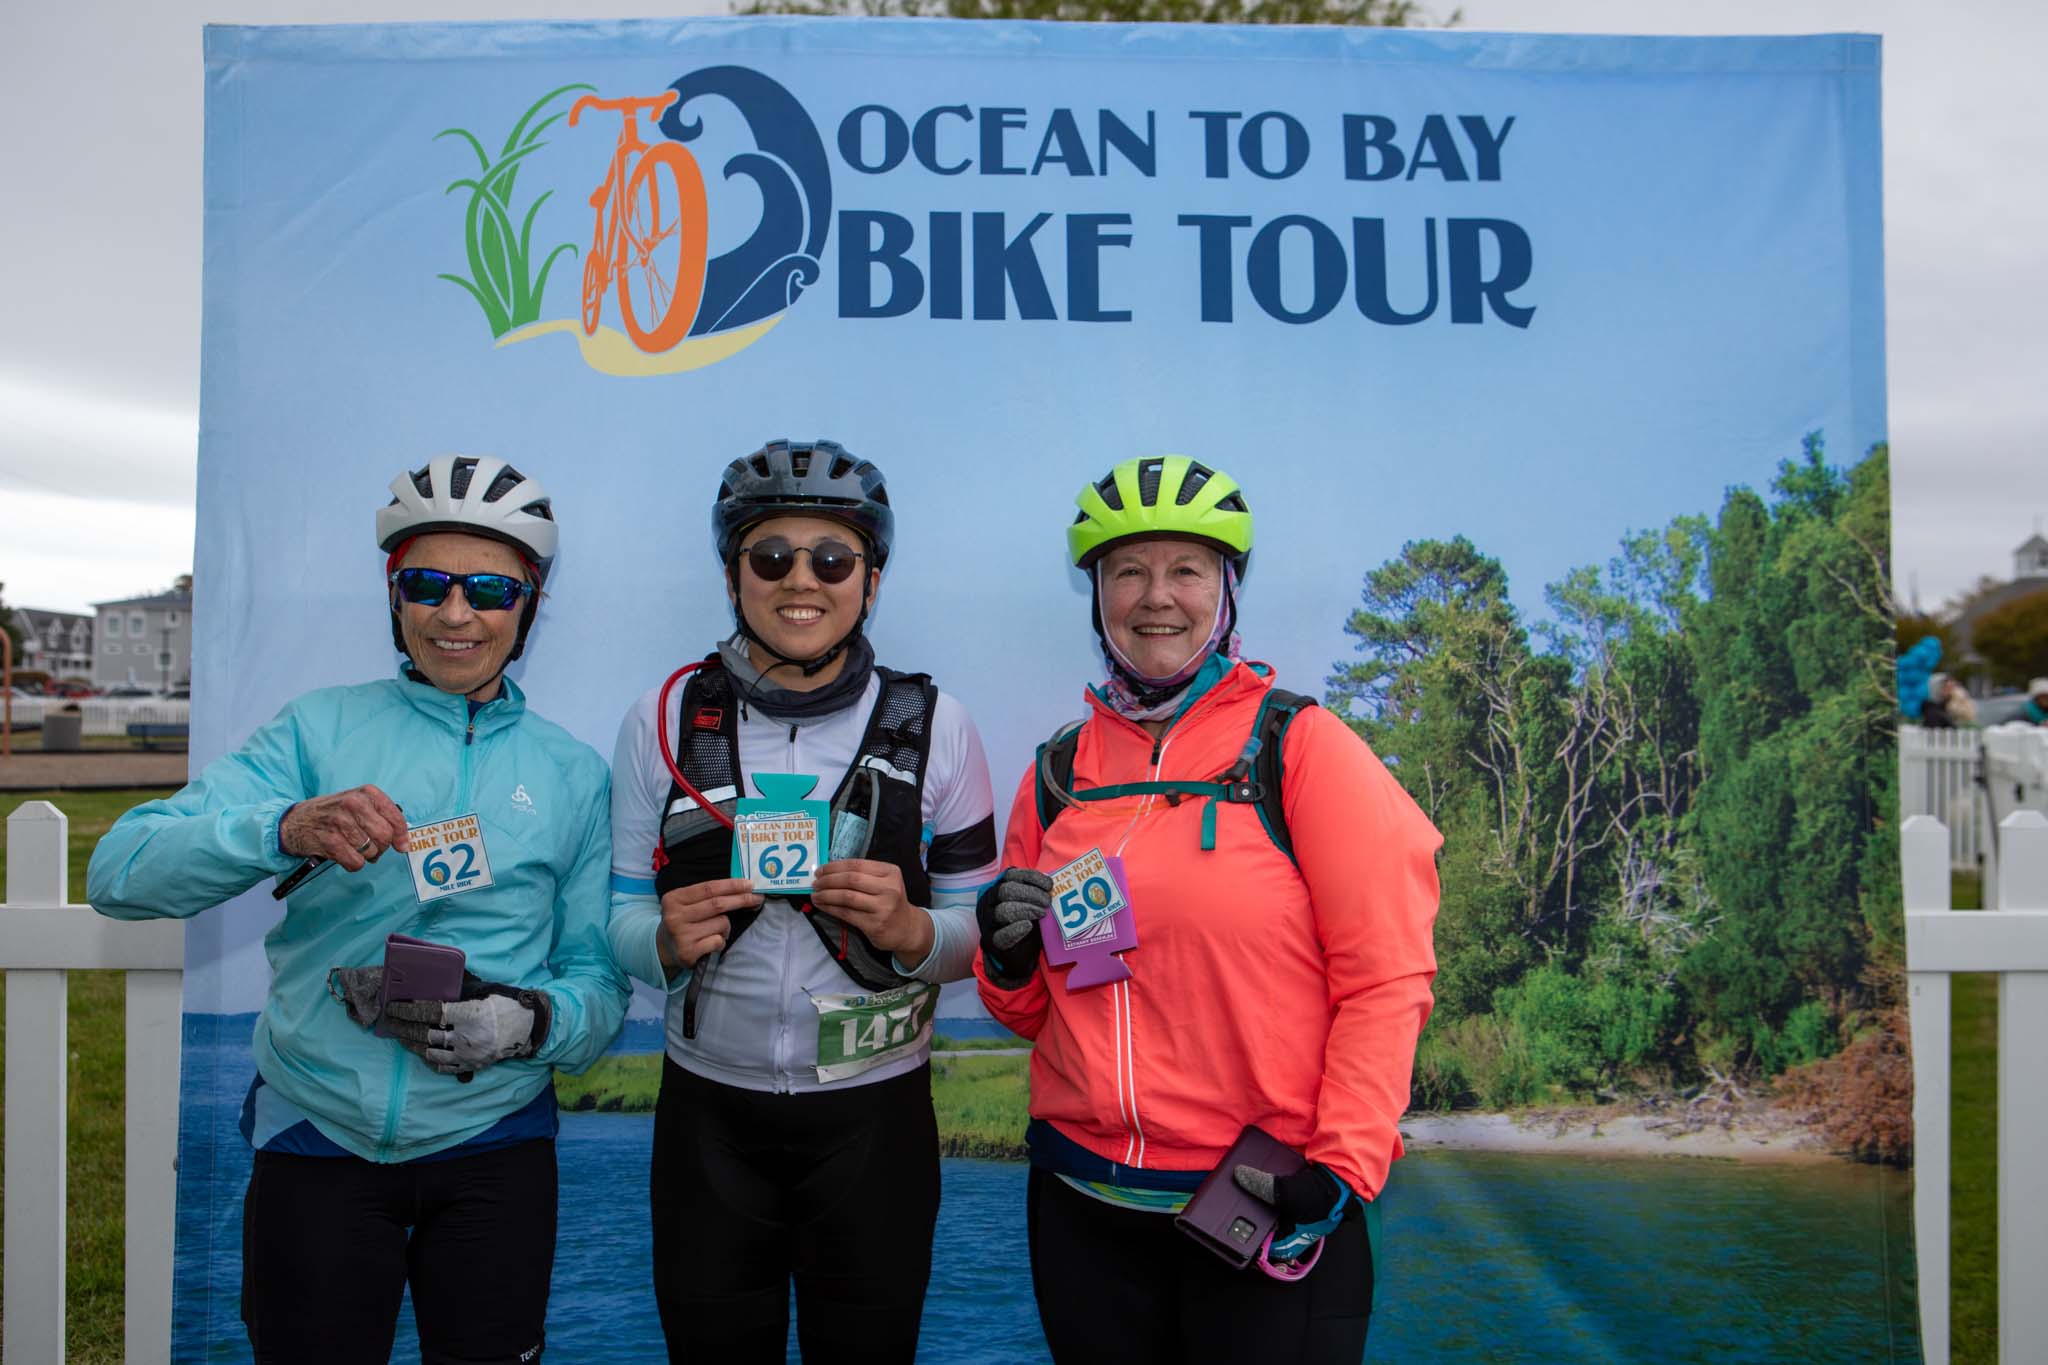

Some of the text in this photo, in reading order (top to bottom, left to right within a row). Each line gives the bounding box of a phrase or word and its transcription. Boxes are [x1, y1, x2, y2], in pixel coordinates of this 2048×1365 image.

[837, 104, 1518, 183] OCEAN TO BAY
[837, 209, 1539, 330] BIKE TOUR
[409, 817, 475, 838] OCEAN TO BAY
[409, 827, 478, 852] BIKE TOUR
[752, 833, 778, 842] BIKE
[784, 831, 814, 841] TOUR
[784, 822, 795, 830] TO
[798, 821, 814, 829] BAY
[423, 843, 480, 886] 62
[759, 844, 809, 878] 62
[1055, 853, 1099, 882] EAN TO BAY
[1051, 860, 1104, 898] BIKE TOUR
[1060, 876, 1111, 928] 50
